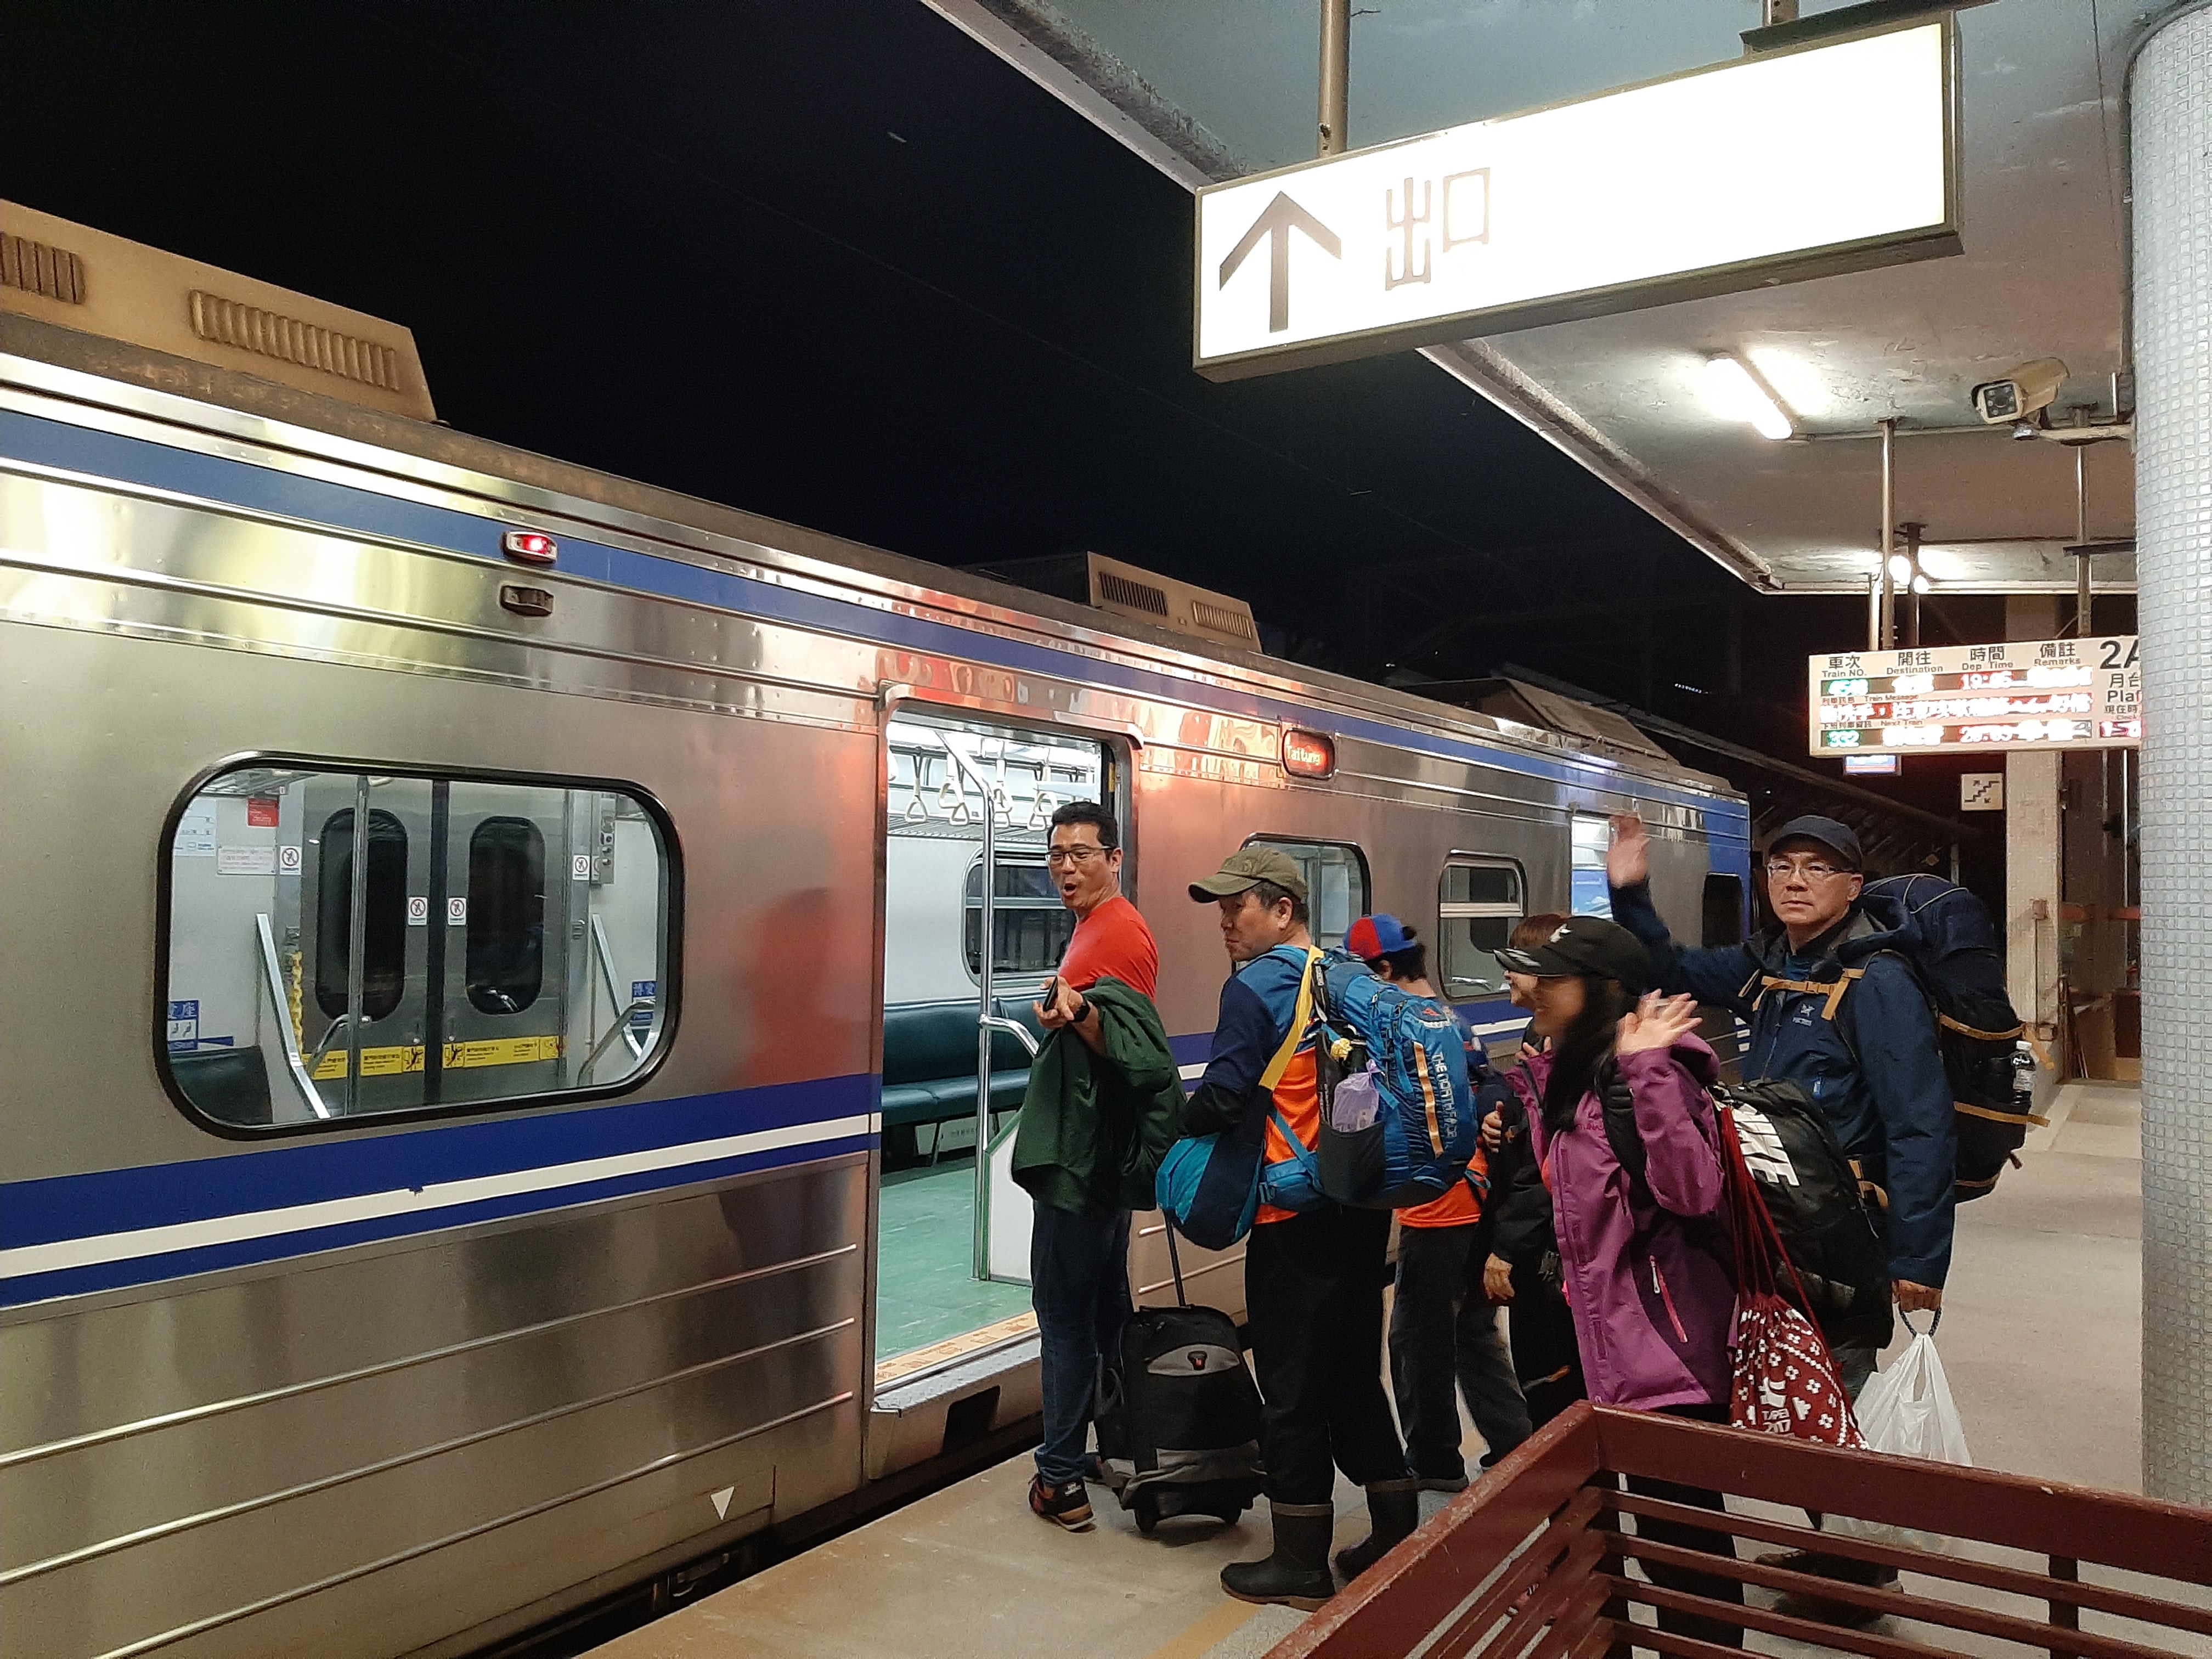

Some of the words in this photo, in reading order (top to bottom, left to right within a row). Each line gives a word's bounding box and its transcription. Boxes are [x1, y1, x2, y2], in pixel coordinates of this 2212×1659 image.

[1385, 167, 1490, 291] 出口
[1970, 646, 2005, 662] 時間
[2040, 642, 2076, 658] 備註
[1828, 654, 1860, 669] 車次
[1898, 650, 1932, 667] 開往
[2034, 657, 2081, 666] Remarks
[1887, 666, 1943, 675] Destination
